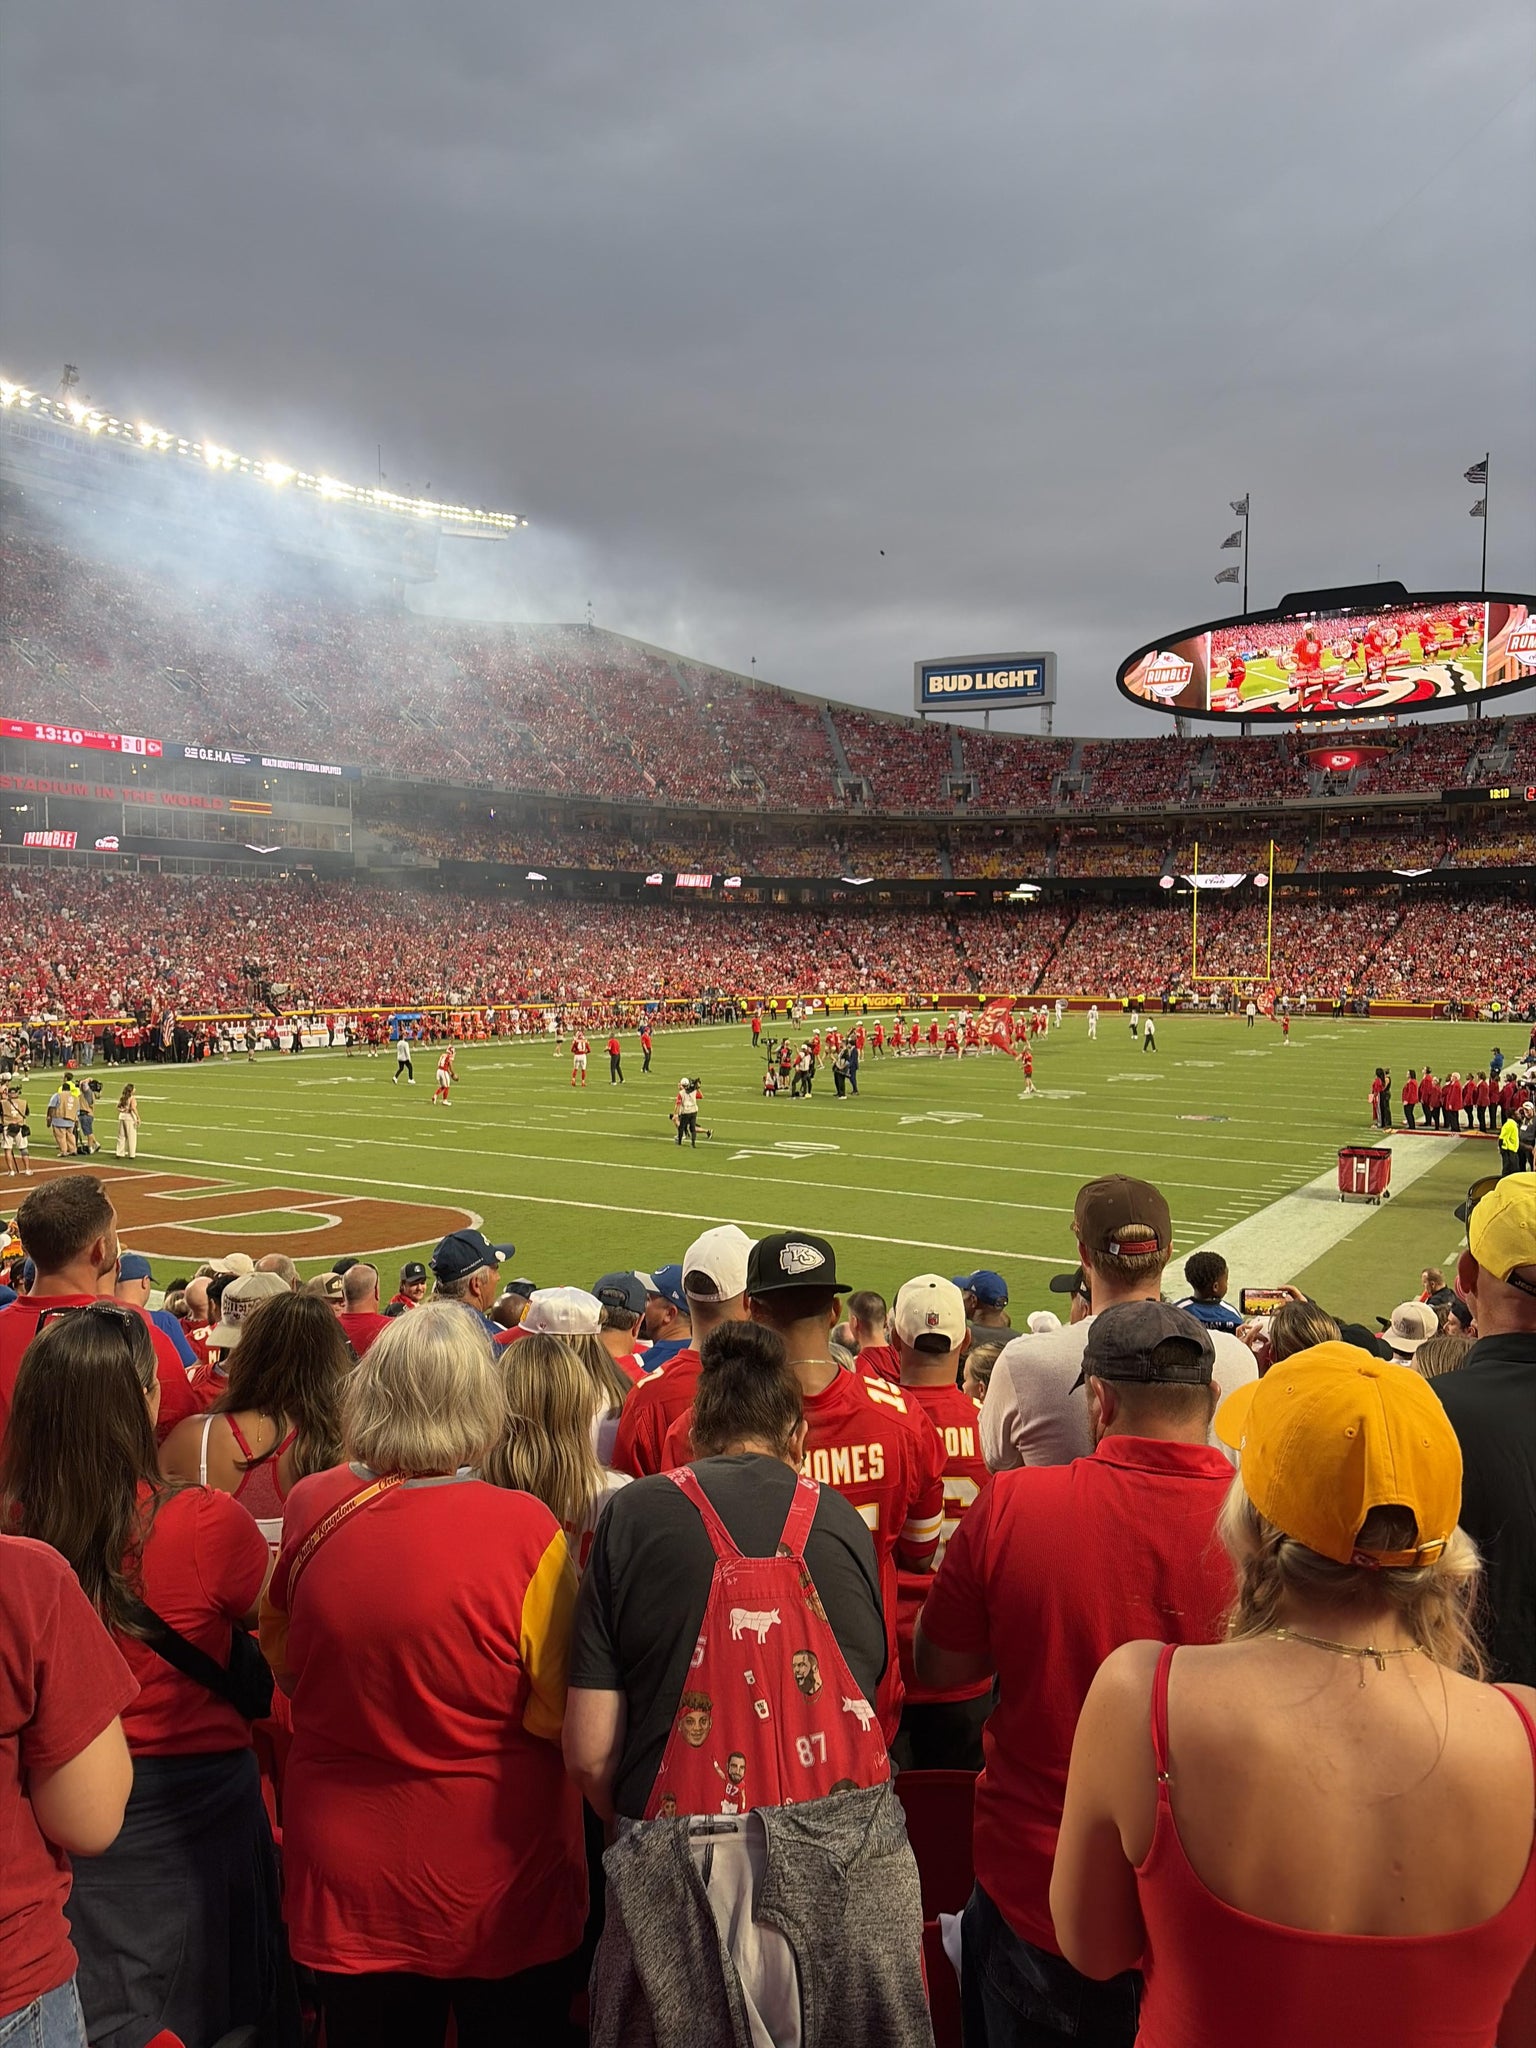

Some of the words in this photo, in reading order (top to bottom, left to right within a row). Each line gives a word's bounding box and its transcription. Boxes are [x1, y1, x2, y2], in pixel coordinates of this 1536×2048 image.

[928, 674, 973, 693] BUD
[975, 669, 1037, 690] LIGHT
[1147, 667, 1188, 684] RUMBLE
[35, 726, 83, 744] 13:10
[199, 747, 231, 764] G.E.H.A
[0, 775, 88, 797] STADIUM
[95, 787, 115, 799] IN
[122, 788, 155, 802] THE
[161, 792, 225, 809] WORLD
[796, 1731, 828, 1768] 87
[725, 1782, 739, 1796] 87
